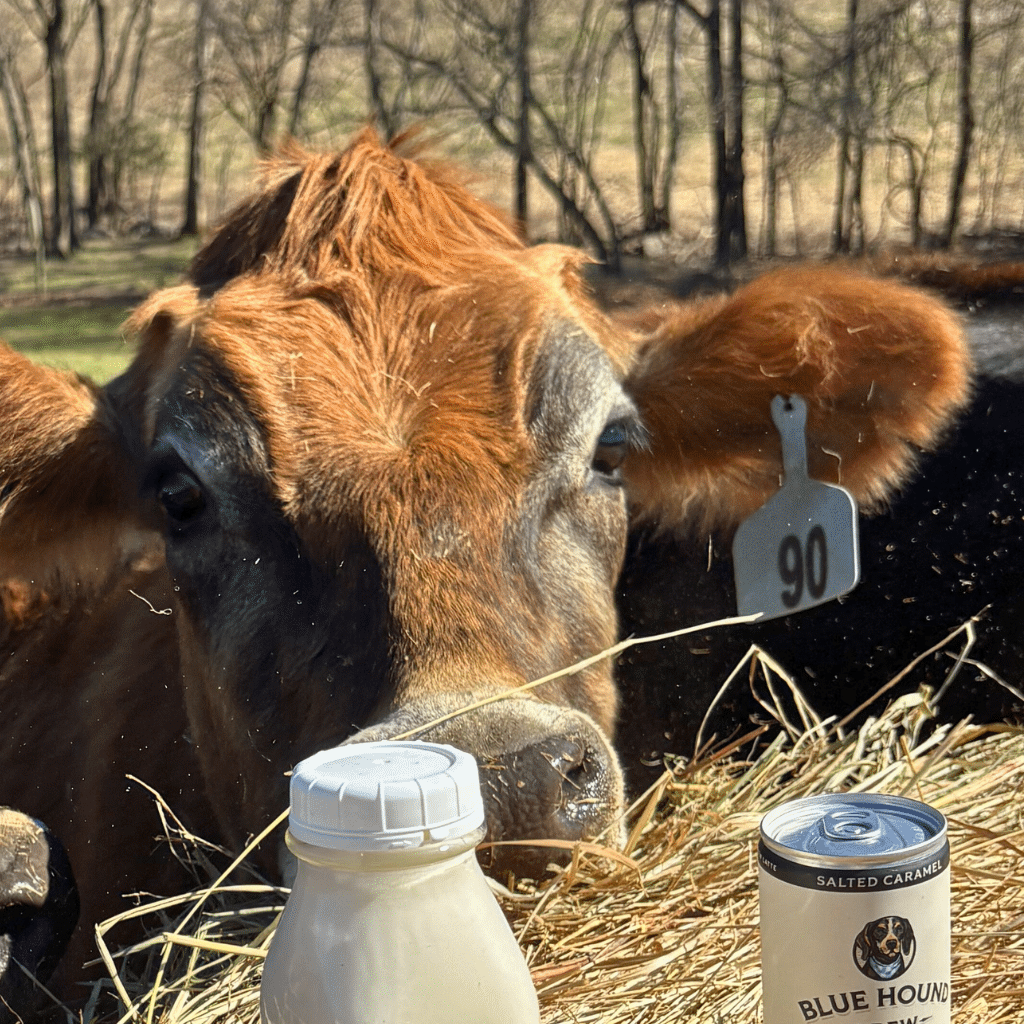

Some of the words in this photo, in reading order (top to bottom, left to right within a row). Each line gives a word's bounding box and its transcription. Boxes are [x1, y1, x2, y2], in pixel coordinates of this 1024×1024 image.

[779, 524, 828, 609] 90
[816, 875, 878, 888] SALTED
[883, 859, 943, 886] CARAMEL
[798, 990, 869, 1021] BLUE
[877, 982, 949, 1007] HOUND
